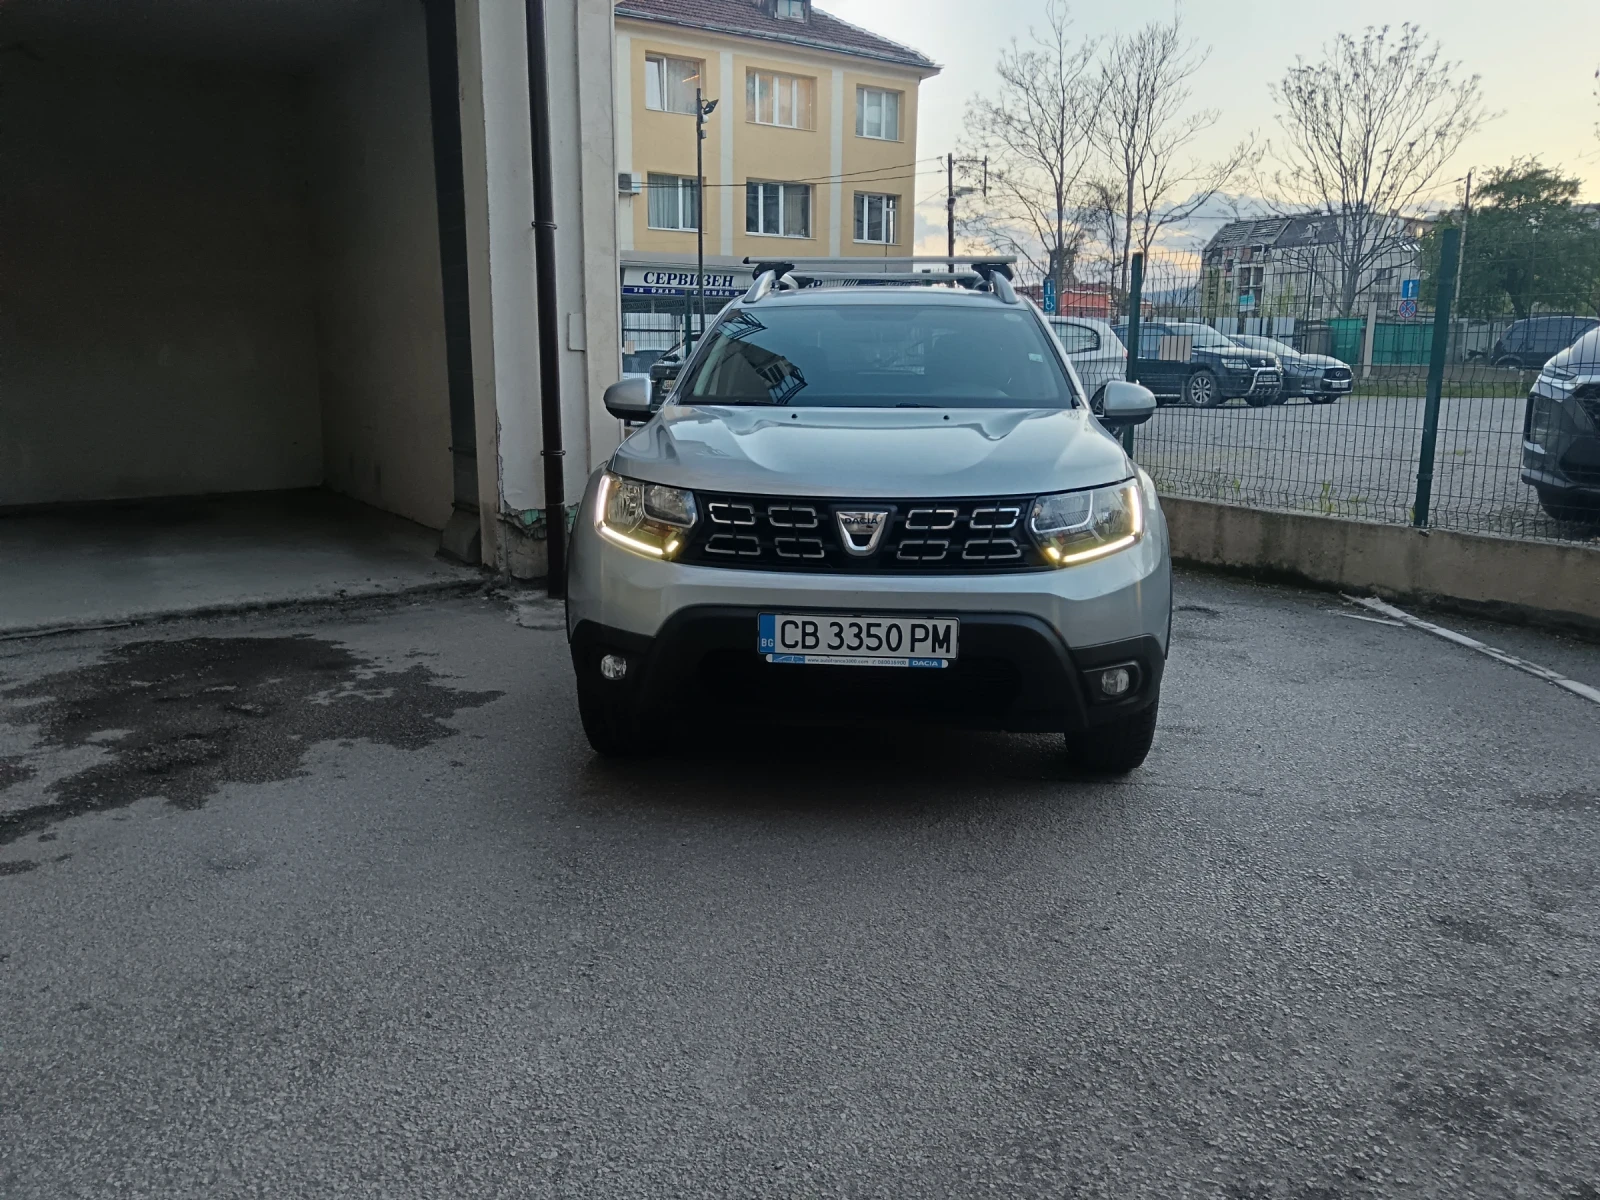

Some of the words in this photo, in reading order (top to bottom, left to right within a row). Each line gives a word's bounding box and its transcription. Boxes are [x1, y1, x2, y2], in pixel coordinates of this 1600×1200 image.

[643, 271, 734, 287] СЕРВИЗЕН
[761, 638, 774, 647] BG
[781, 620, 820, 649] CB
[827, 621, 903, 652] 3350
[910, 623, 951, 653] PM
